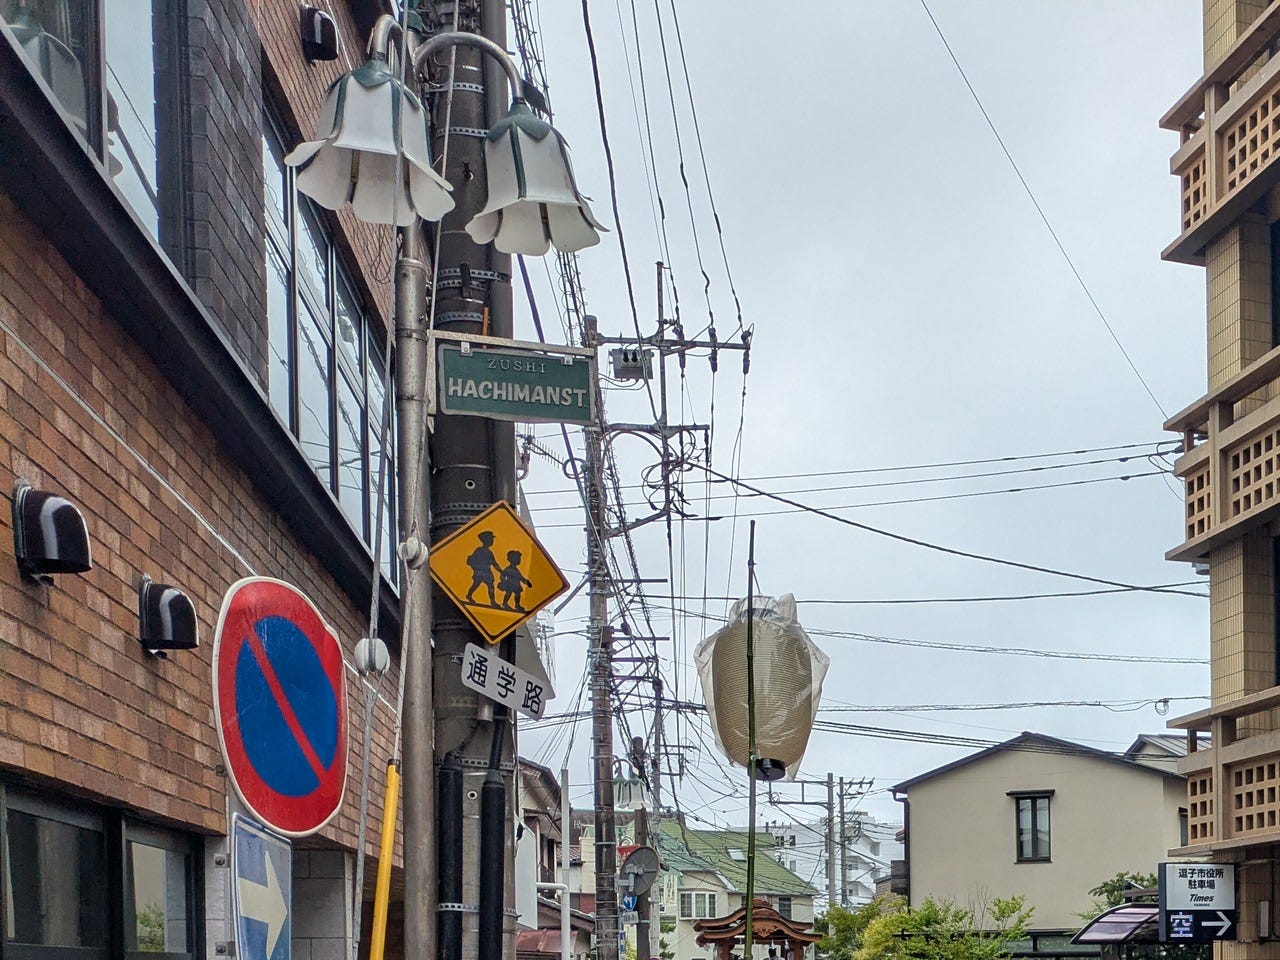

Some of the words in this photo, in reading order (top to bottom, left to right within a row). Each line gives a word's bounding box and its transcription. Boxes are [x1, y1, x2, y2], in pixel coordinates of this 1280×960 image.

[487, 358, 547, 373] ZUSHI
[466, 650, 543, 715] 通学路
[1178, 868, 1224, 879] 逗子市役所
[1187, 879, 1216, 890] 駐車場
[1189, 893, 1215, 902] Times
[1170, 911, 1193, 938] 空
